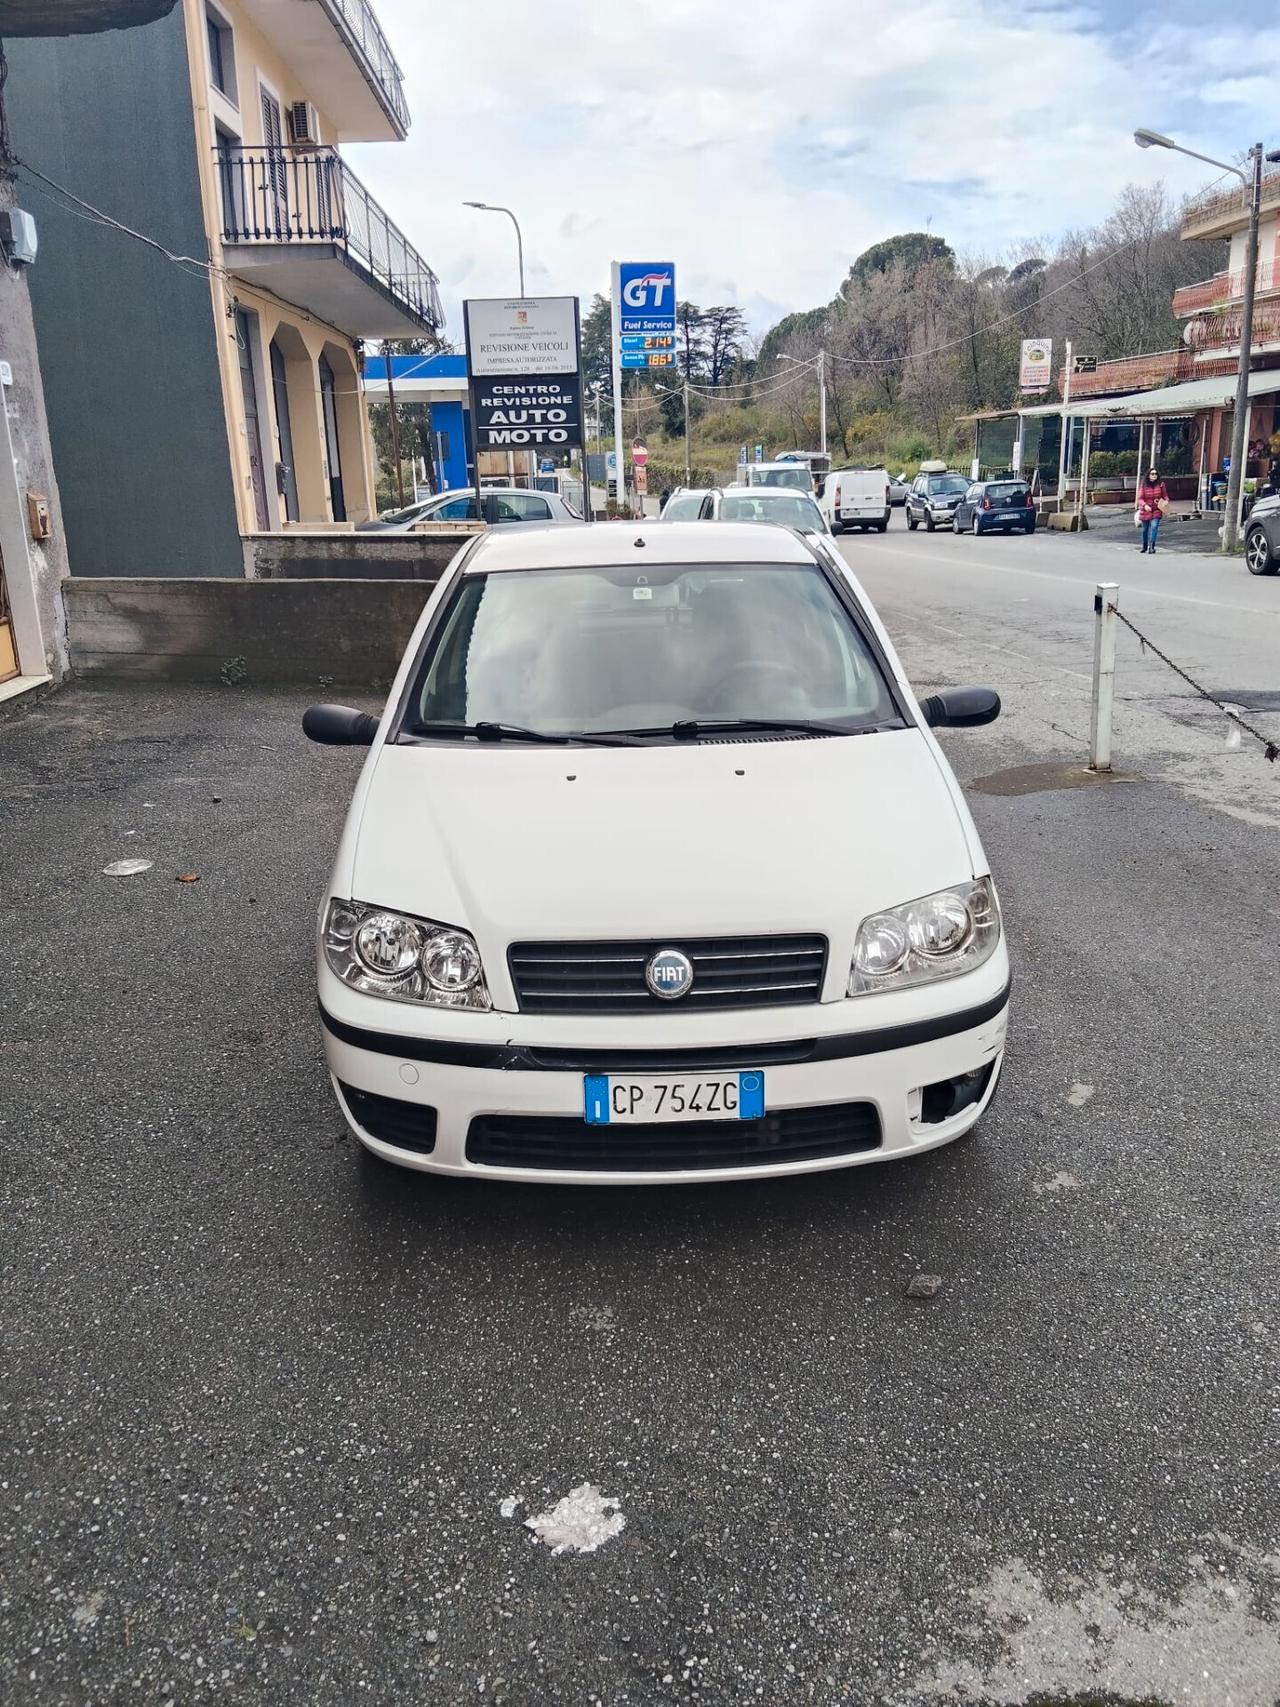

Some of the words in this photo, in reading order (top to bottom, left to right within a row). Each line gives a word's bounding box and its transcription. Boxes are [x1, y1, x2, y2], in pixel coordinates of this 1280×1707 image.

[623, 272, 672, 307] GT
[624, 321, 641, 329] Fuel
[643, 320, 673, 329] Service
[480, 344, 530, 353] REVISIONE
[531, 341, 569, 351] VEICOLI
[492, 385, 561, 394] CENTRO
[481, 395, 573, 406] REVISIONE
[489, 408, 567, 424] AUTO
[488, 428, 568, 444] MOTO
[654, 966, 685, 982] FIAT
[612, 1084, 644, 1115] CP
[653, 1081, 738, 1114] 754ZG
